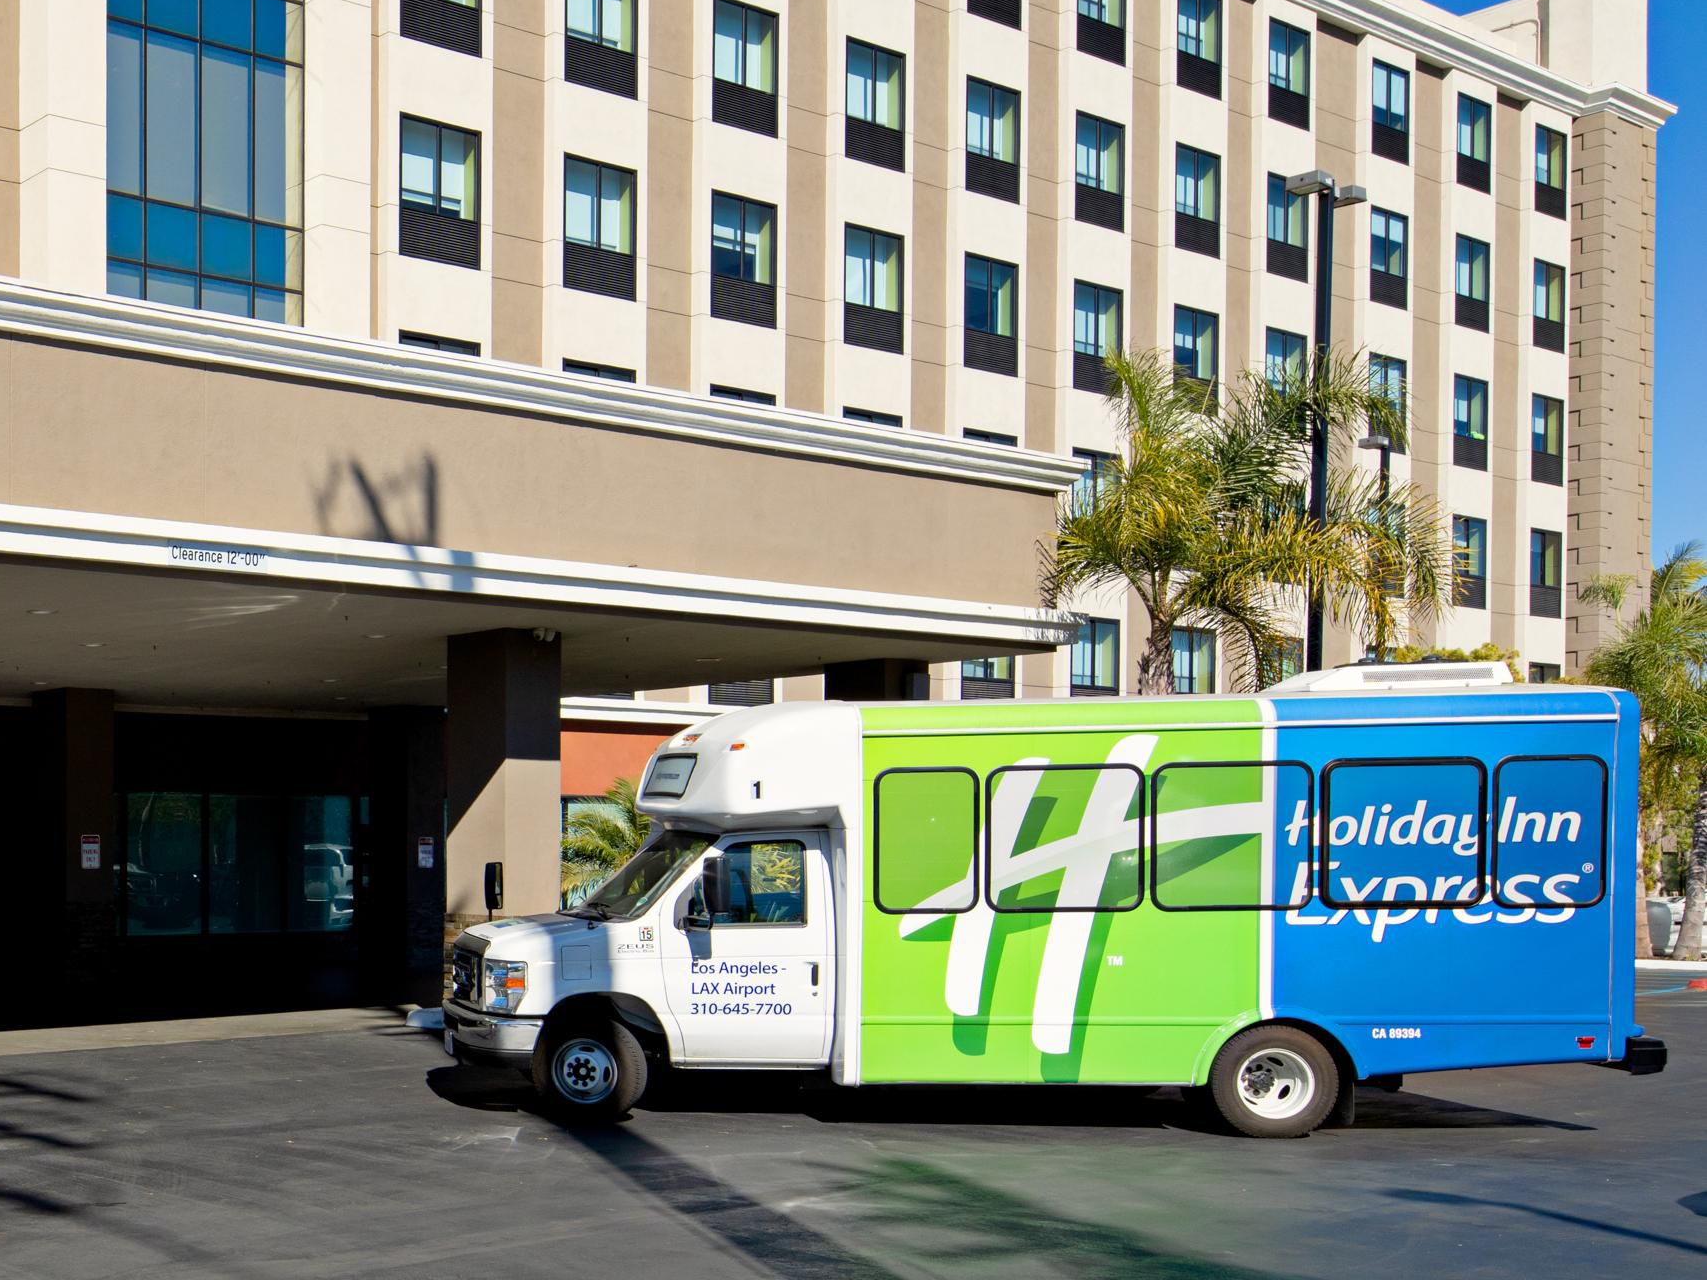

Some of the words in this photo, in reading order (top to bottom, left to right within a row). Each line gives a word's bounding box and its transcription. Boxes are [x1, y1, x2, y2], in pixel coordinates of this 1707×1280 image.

[172, 545, 222, 563] Clearance
[753, 781, 761, 799] 1
[1284, 799, 1491, 857] Holiday
[1497, 796, 1582, 843] Inn
[1285, 861, 1581, 943] Express
[641, 930, 652, 940] 15
[691, 961, 715, 974] Los
[719, 961, 778, 977] Angeles
[691, 982, 720, 995] LAX
[723, 982, 776, 998] Airport
[690, 1003, 792, 1015] 310-645-7700
[1372, 1028, 1387, 1038] CA
[1389, 1028, 1421, 1039] 89394
